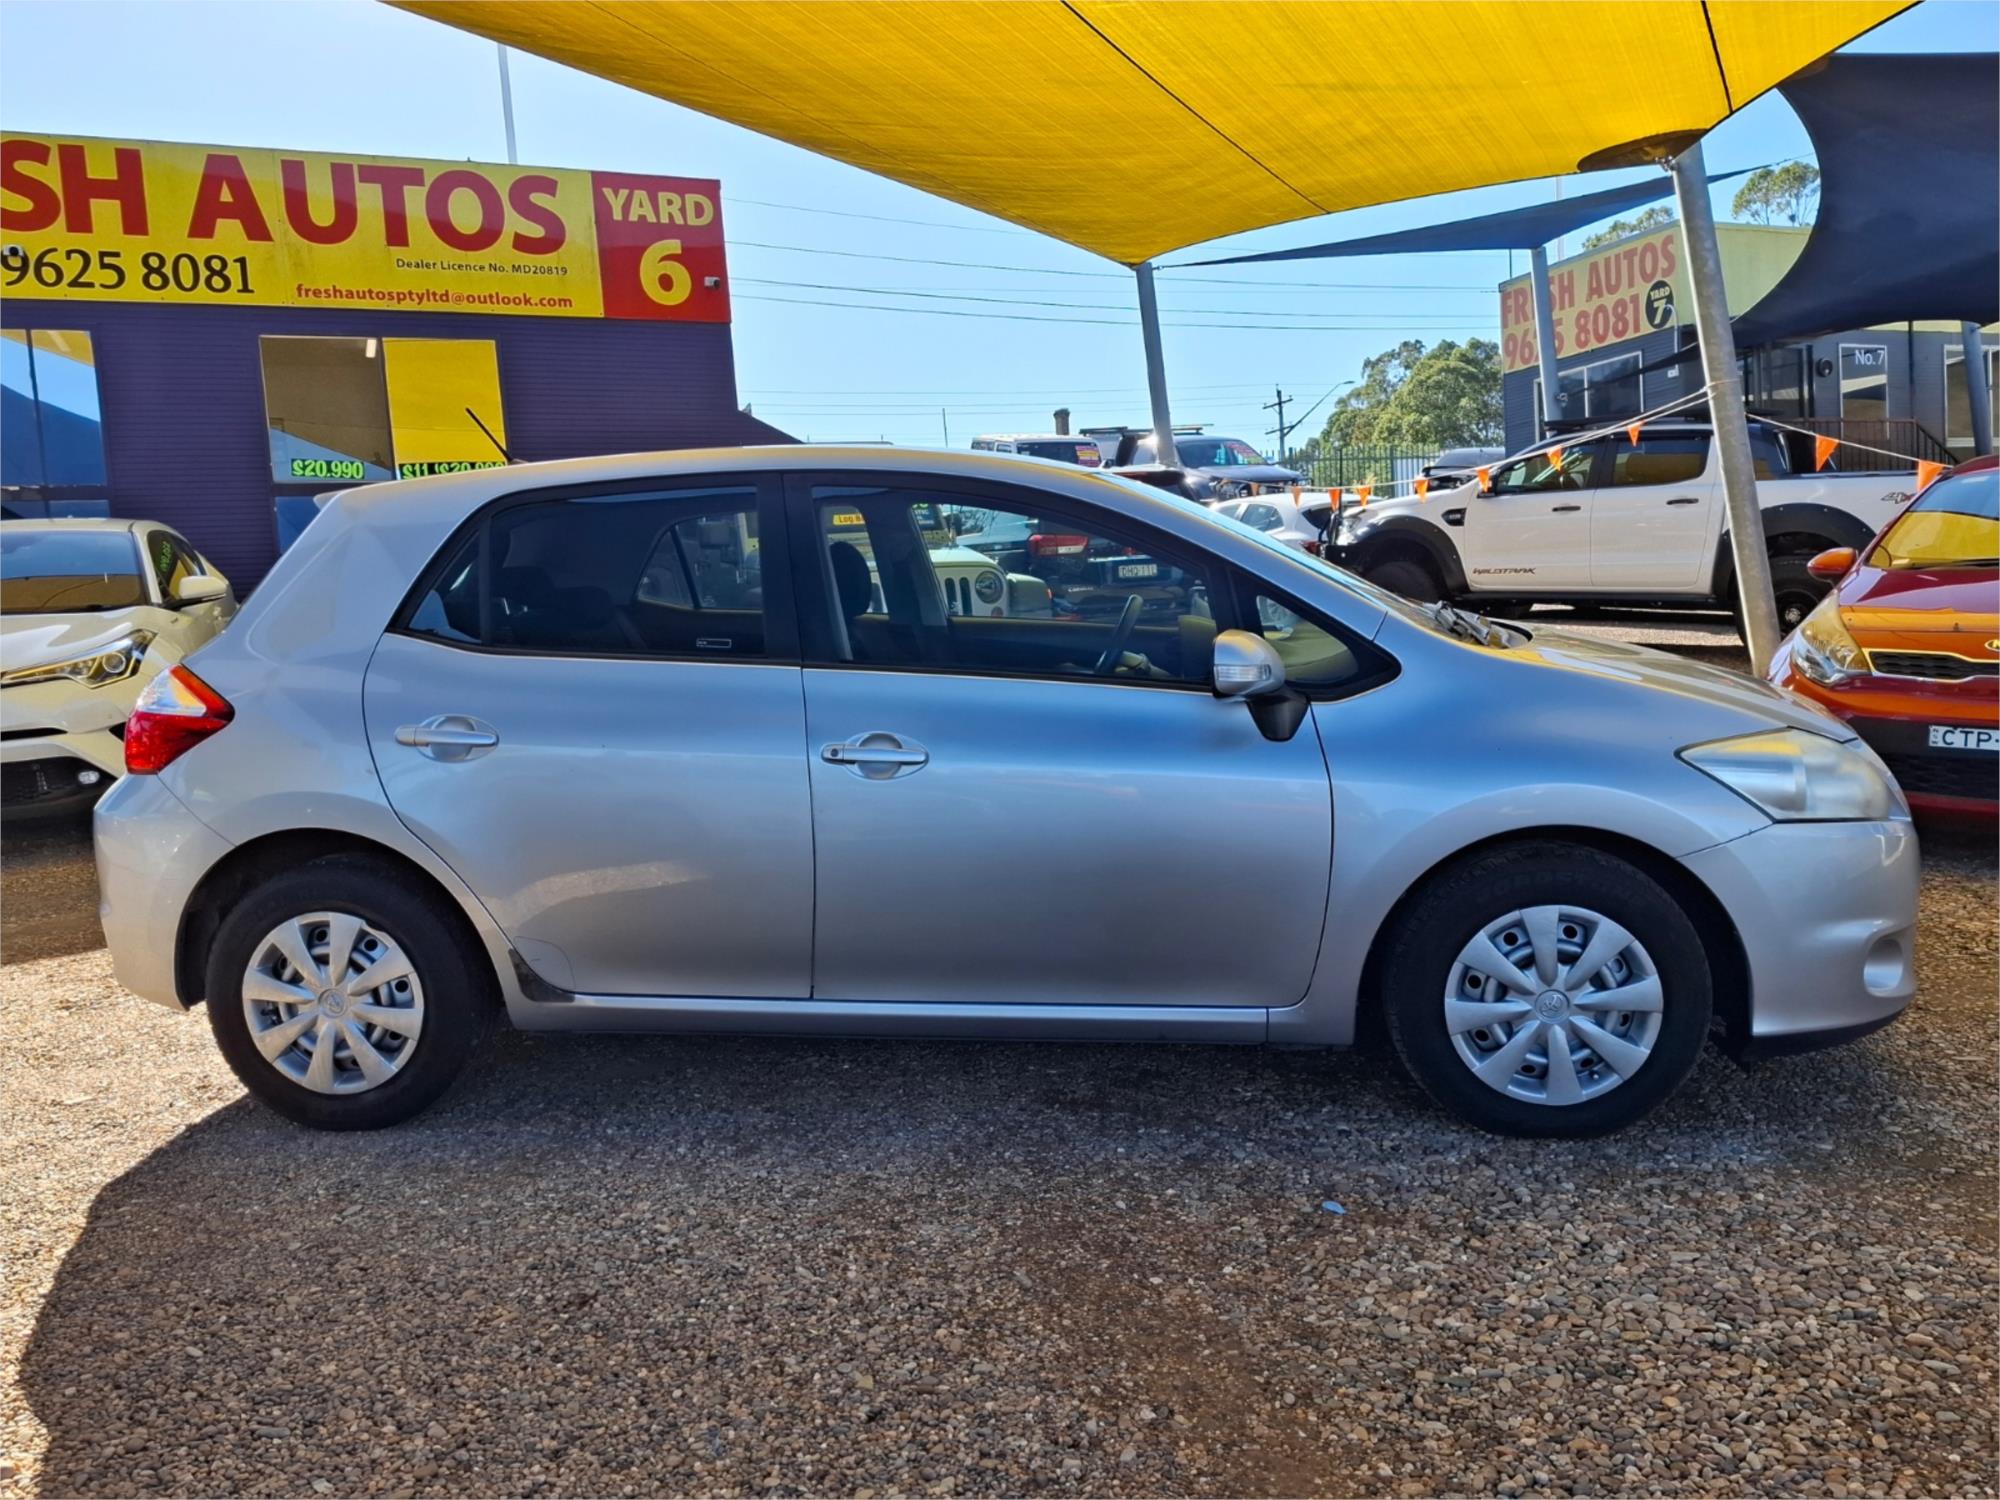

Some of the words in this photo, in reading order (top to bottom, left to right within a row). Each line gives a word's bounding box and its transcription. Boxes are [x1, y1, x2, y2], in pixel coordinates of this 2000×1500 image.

[187, 153, 567, 256] AUTOS
[602, 187, 714, 226] YARD
[1, 246, 126, 289] 9625
[141, 252, 255, 294] 8081
[396, 258, 436, 270] Dealer
[440, 260, 485, 272] Licence
[488, 262, 508, 273] No.
[512, 264, 567, 276] MD20819
[639, 239, 692, 306] 6
[1501, 270, 1575, 329] FRSH
[1586, 234, 1676, 302] AUTOS
[296, 283, 573, 308] freshautosptyltd@outlook.com
[1650, 286, 1671, 300] YARD
[1654, 299, 1668, 324] 7
[1504, 317, 1564, 369] 965
[1575, 293, 1641, 349] 8081
